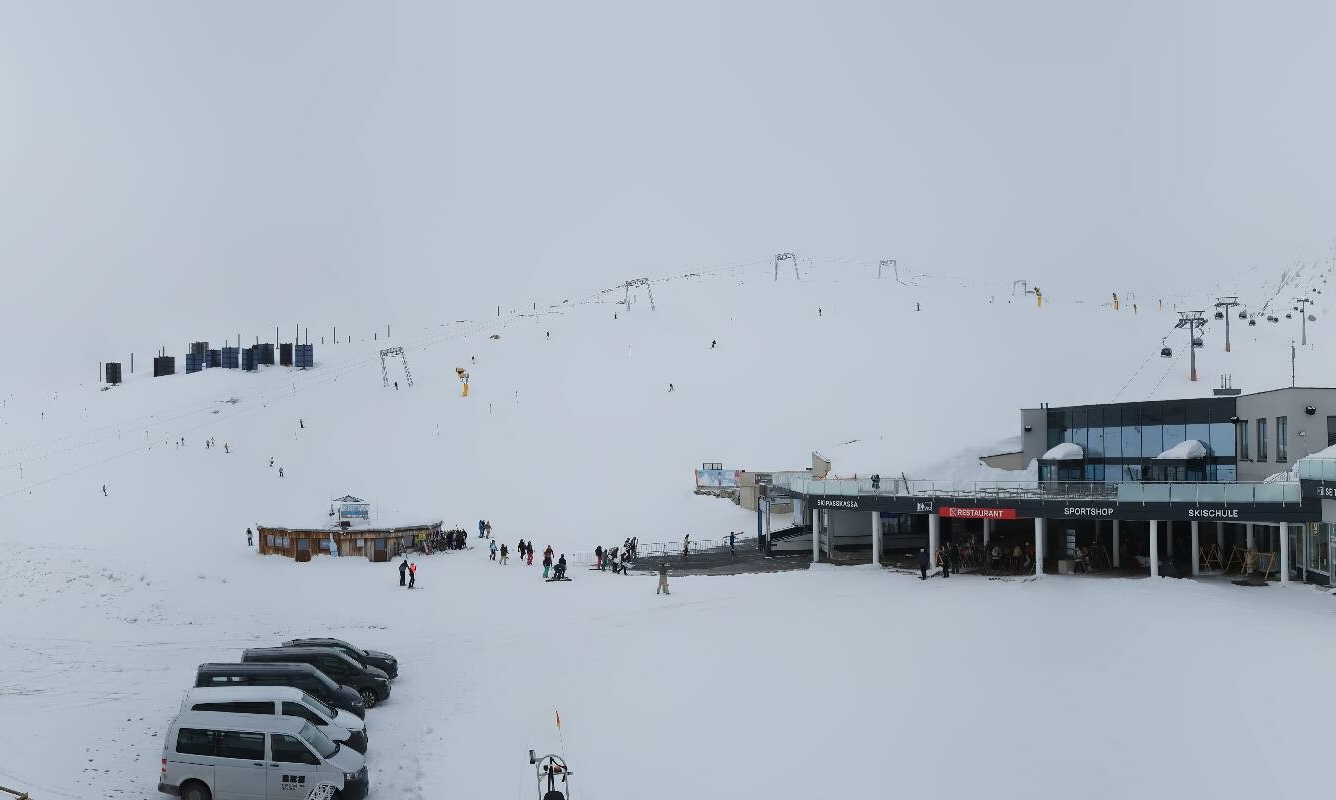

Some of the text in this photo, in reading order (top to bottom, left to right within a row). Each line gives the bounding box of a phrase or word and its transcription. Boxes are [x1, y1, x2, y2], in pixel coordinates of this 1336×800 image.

[957, 508, 1004, 517] RESTAURANT
[1064, 507, 1114, 516] SPORTSHOP
[1188, 509, 1239, 518] SKISCHULE
